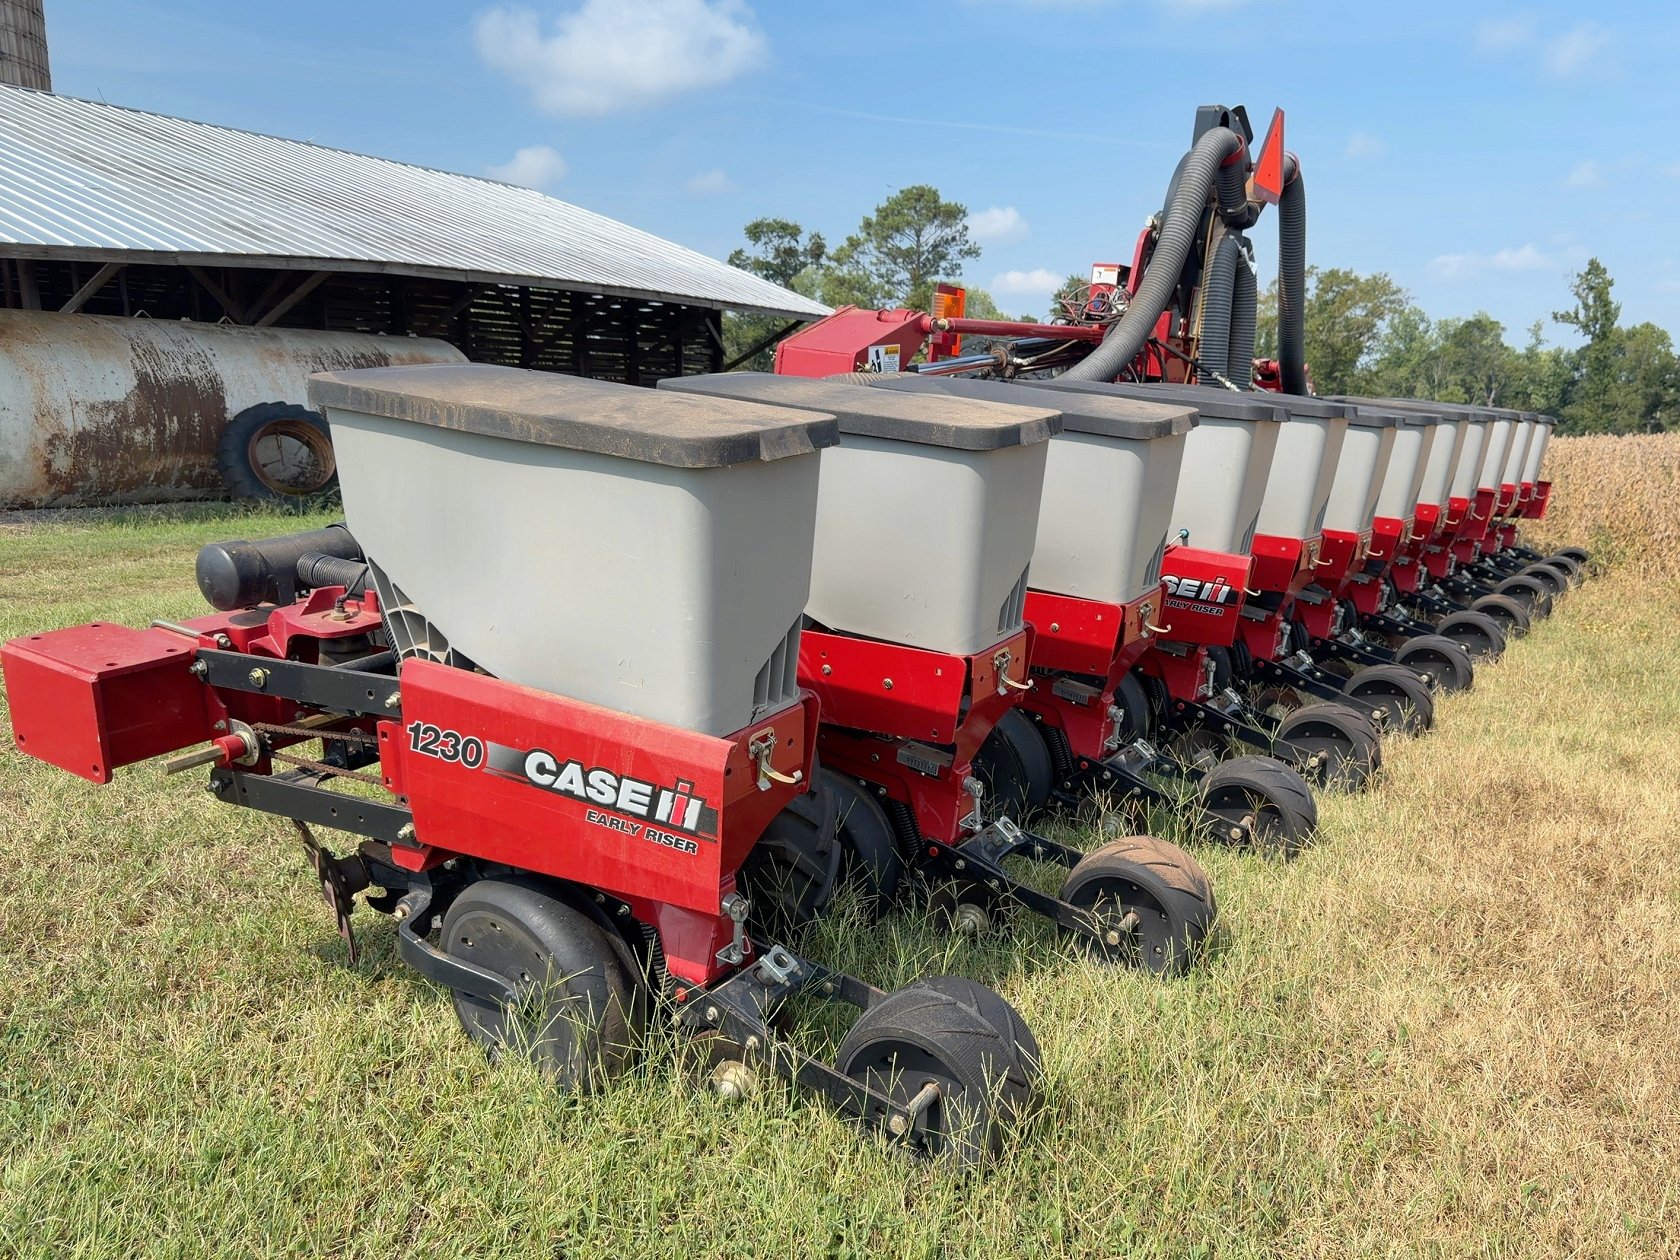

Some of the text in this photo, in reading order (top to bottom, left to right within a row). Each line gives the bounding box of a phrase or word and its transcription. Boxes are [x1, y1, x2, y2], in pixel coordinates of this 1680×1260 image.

[1160, 575, 1201, 598] SE
[1191, 603, 1224, 616] RISER
[407, 721, 484, 769] 1230
[585, 809, 698, 855] EARLY RISER
